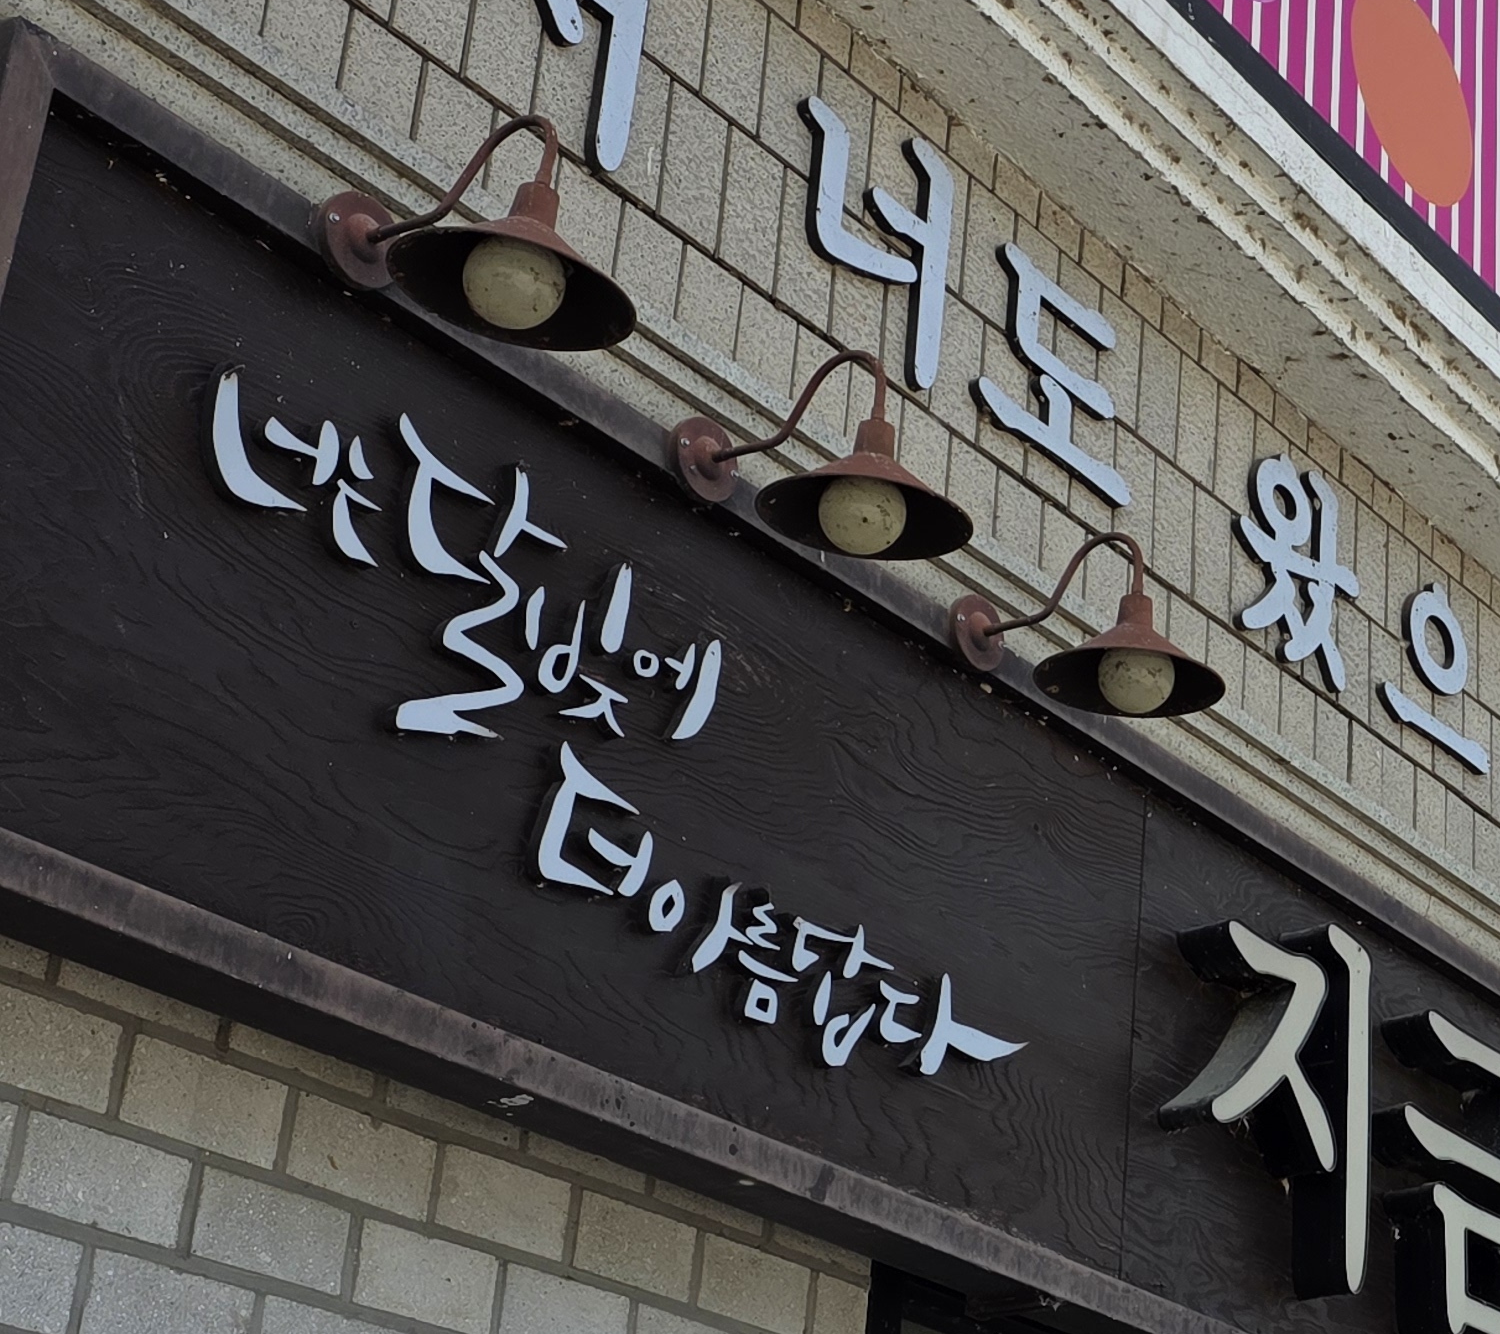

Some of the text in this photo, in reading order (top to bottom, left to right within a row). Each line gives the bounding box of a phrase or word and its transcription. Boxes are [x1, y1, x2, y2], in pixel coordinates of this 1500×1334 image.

[803, 95, 1131, 507] 너도
[394, 413, 721, 741] 달빛에
[537, 741, 1031, 1075] 더 아름답다
